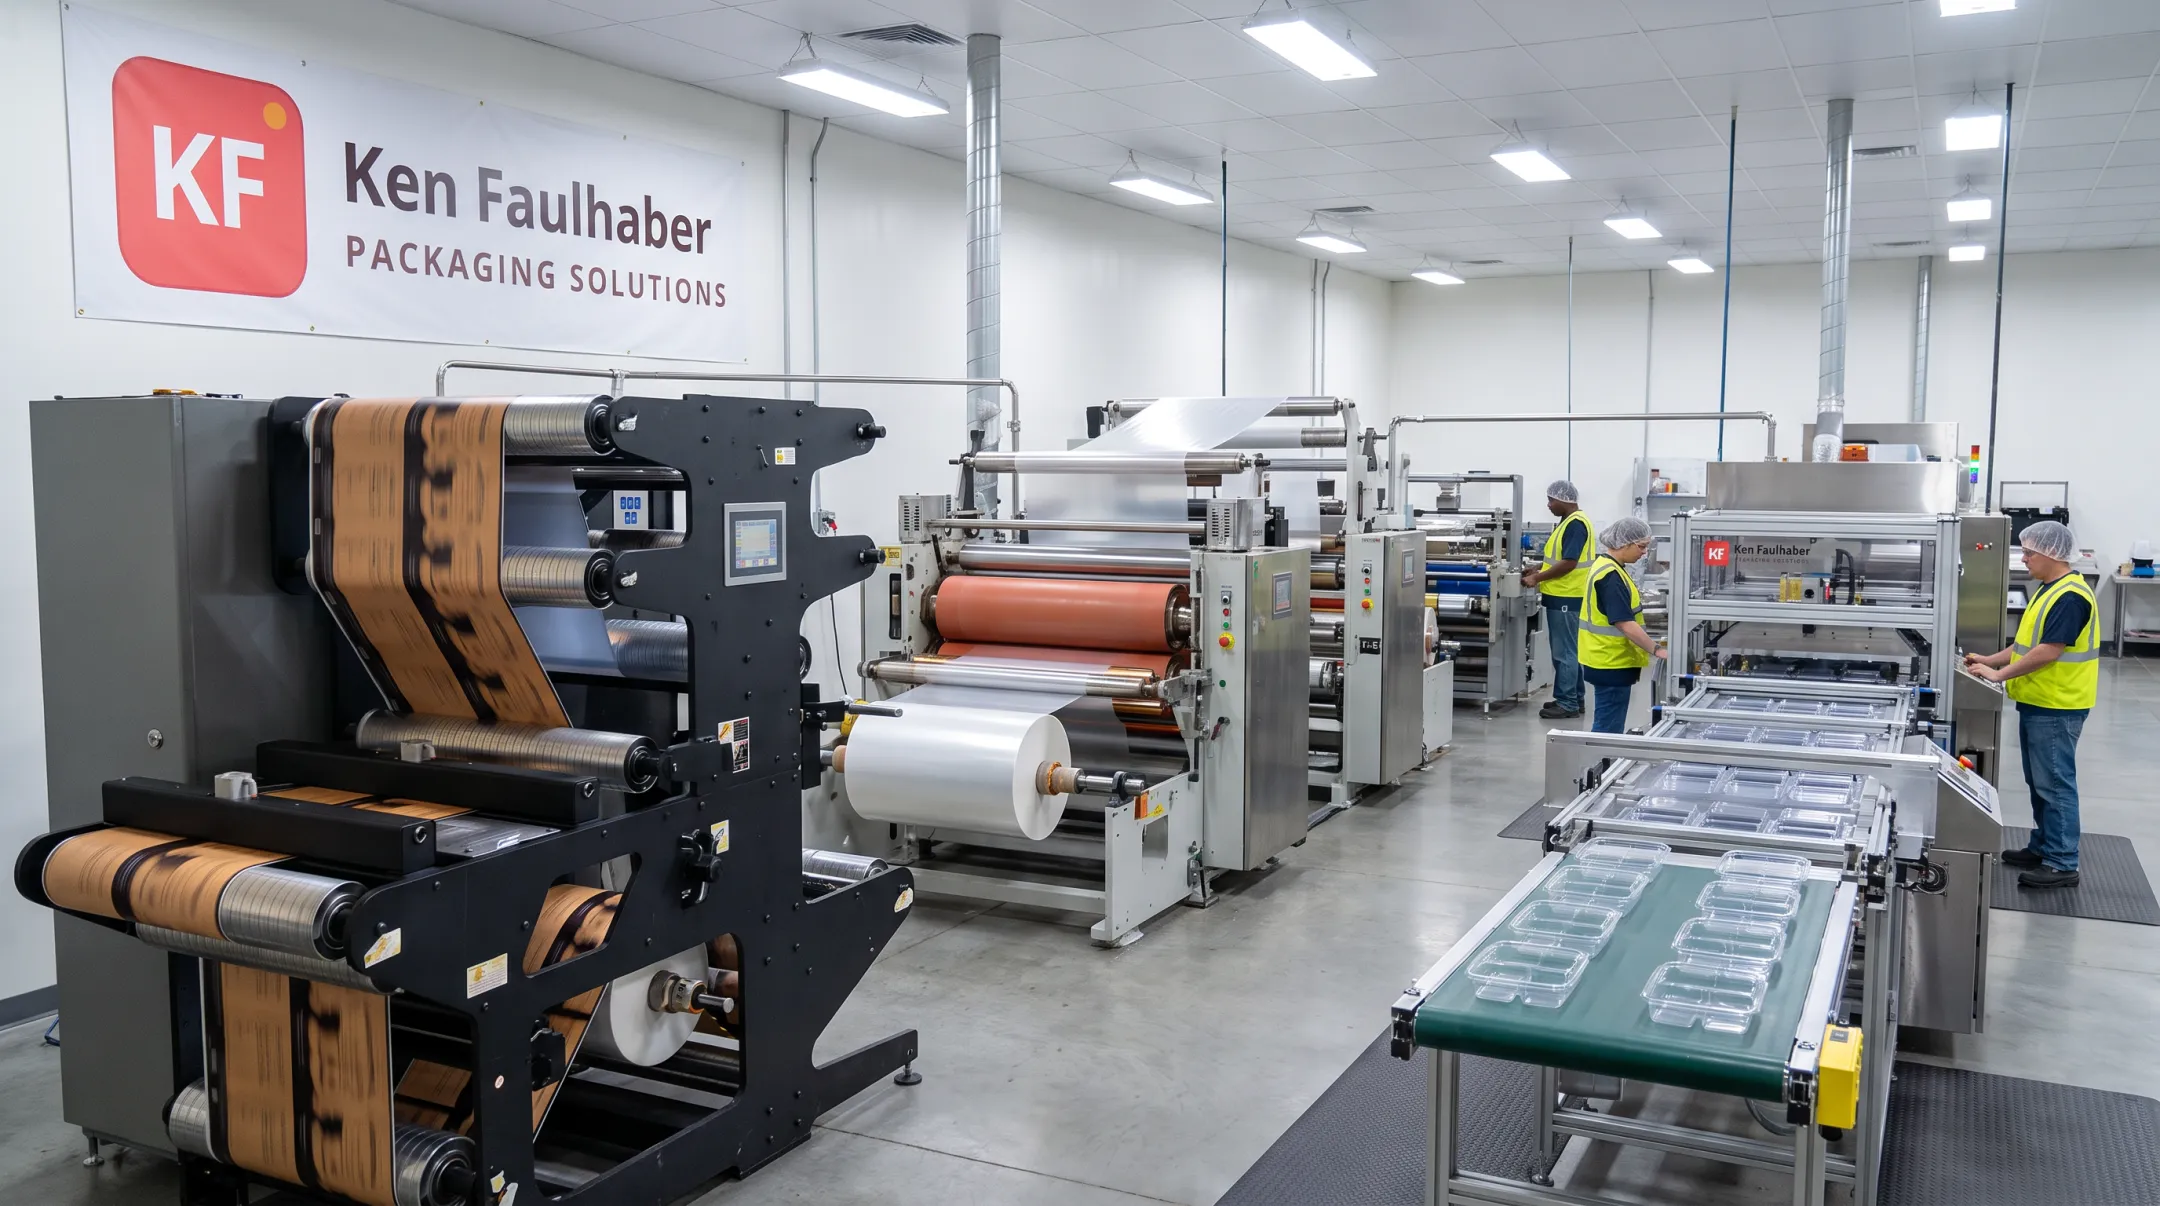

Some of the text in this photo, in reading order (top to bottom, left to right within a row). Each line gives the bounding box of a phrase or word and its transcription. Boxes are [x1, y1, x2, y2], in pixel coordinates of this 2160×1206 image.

[153, 125, 265, 229] KF
[345, 141, 711, 254] Ken Faulhaber
[346, 235, 726, 307] PACKAGING SOLUTIONS
[1708, 548, 1724, 560] KF
[1734, 544, 1810, 556] Ken Faulhaber
